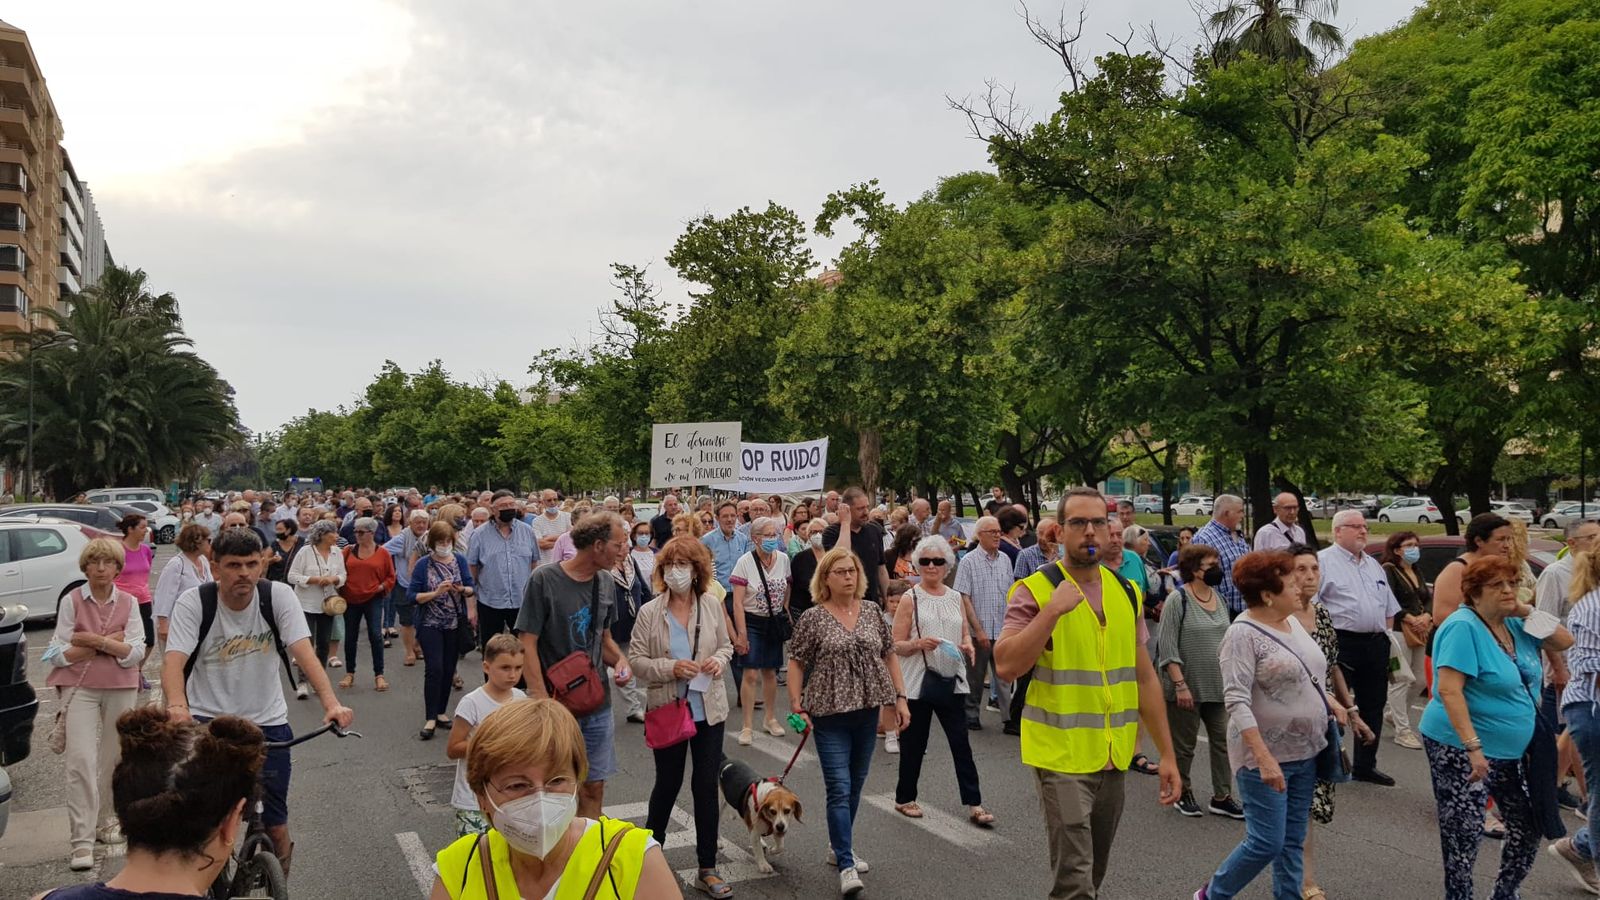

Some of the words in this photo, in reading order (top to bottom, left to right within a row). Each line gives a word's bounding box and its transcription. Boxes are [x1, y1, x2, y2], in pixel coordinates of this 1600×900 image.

[665, 433, 680, 448] El
[687, 431, 729, 449] descanso
[665, 457, 674, 465] es
[681, 456, 693, 466] un
[700, 450, 733, 463] DERECHO
[741, 449, 764, 471] OP
[771, 446, 820, 471] RUIDO
[692, 467, 732, 480] PRIVILEGIO
